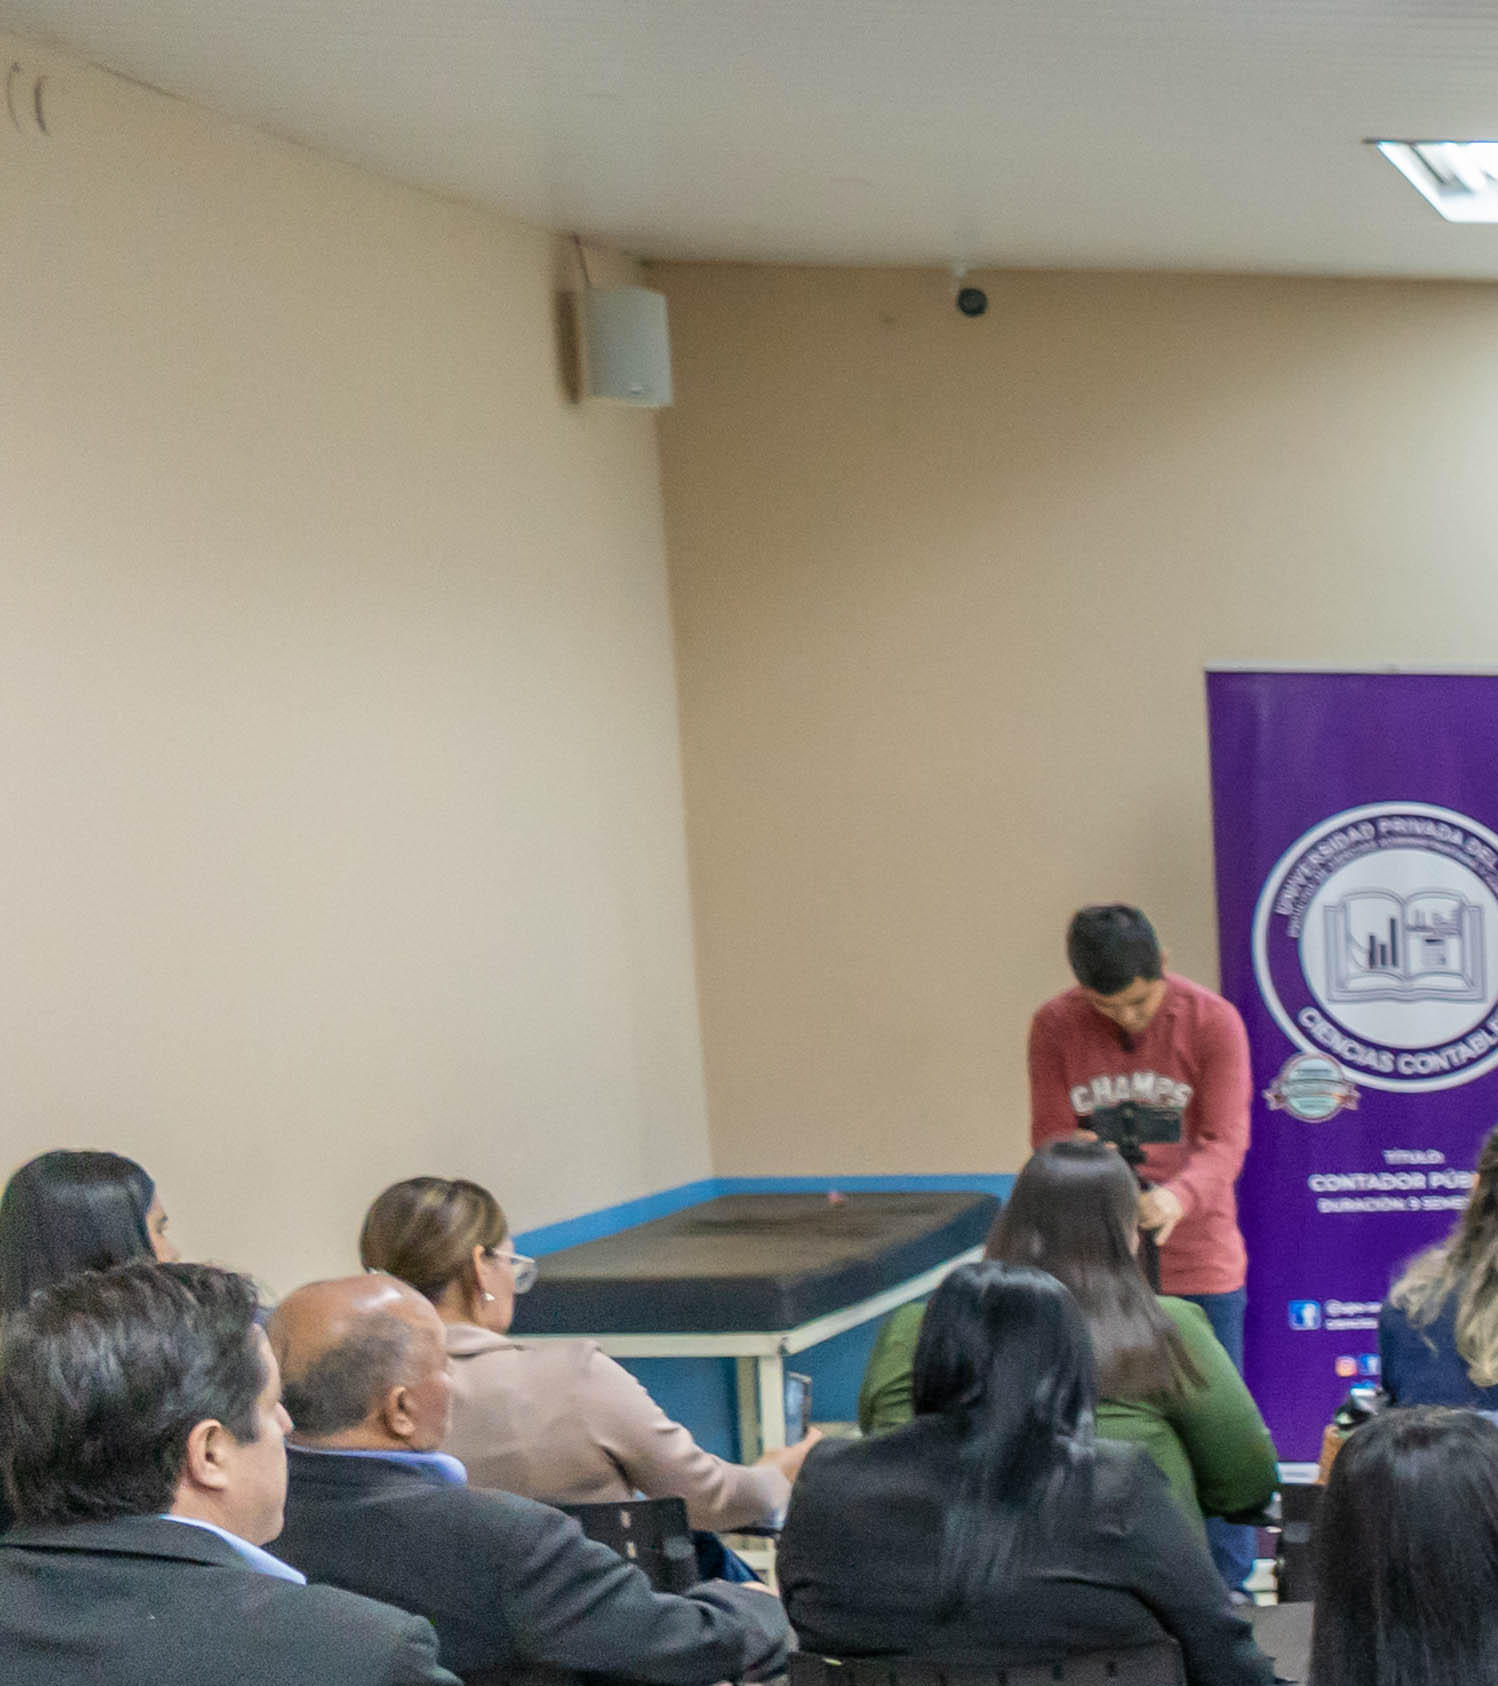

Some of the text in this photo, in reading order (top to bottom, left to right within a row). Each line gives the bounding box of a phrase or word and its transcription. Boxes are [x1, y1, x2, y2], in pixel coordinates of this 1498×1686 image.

[1376, 816, 1464, 846] PRIVADA
[1299, 1005, 1395, 1073] CIENCIAS
[1307, 1168, 1474, 1193] CONTADOR PÚB
